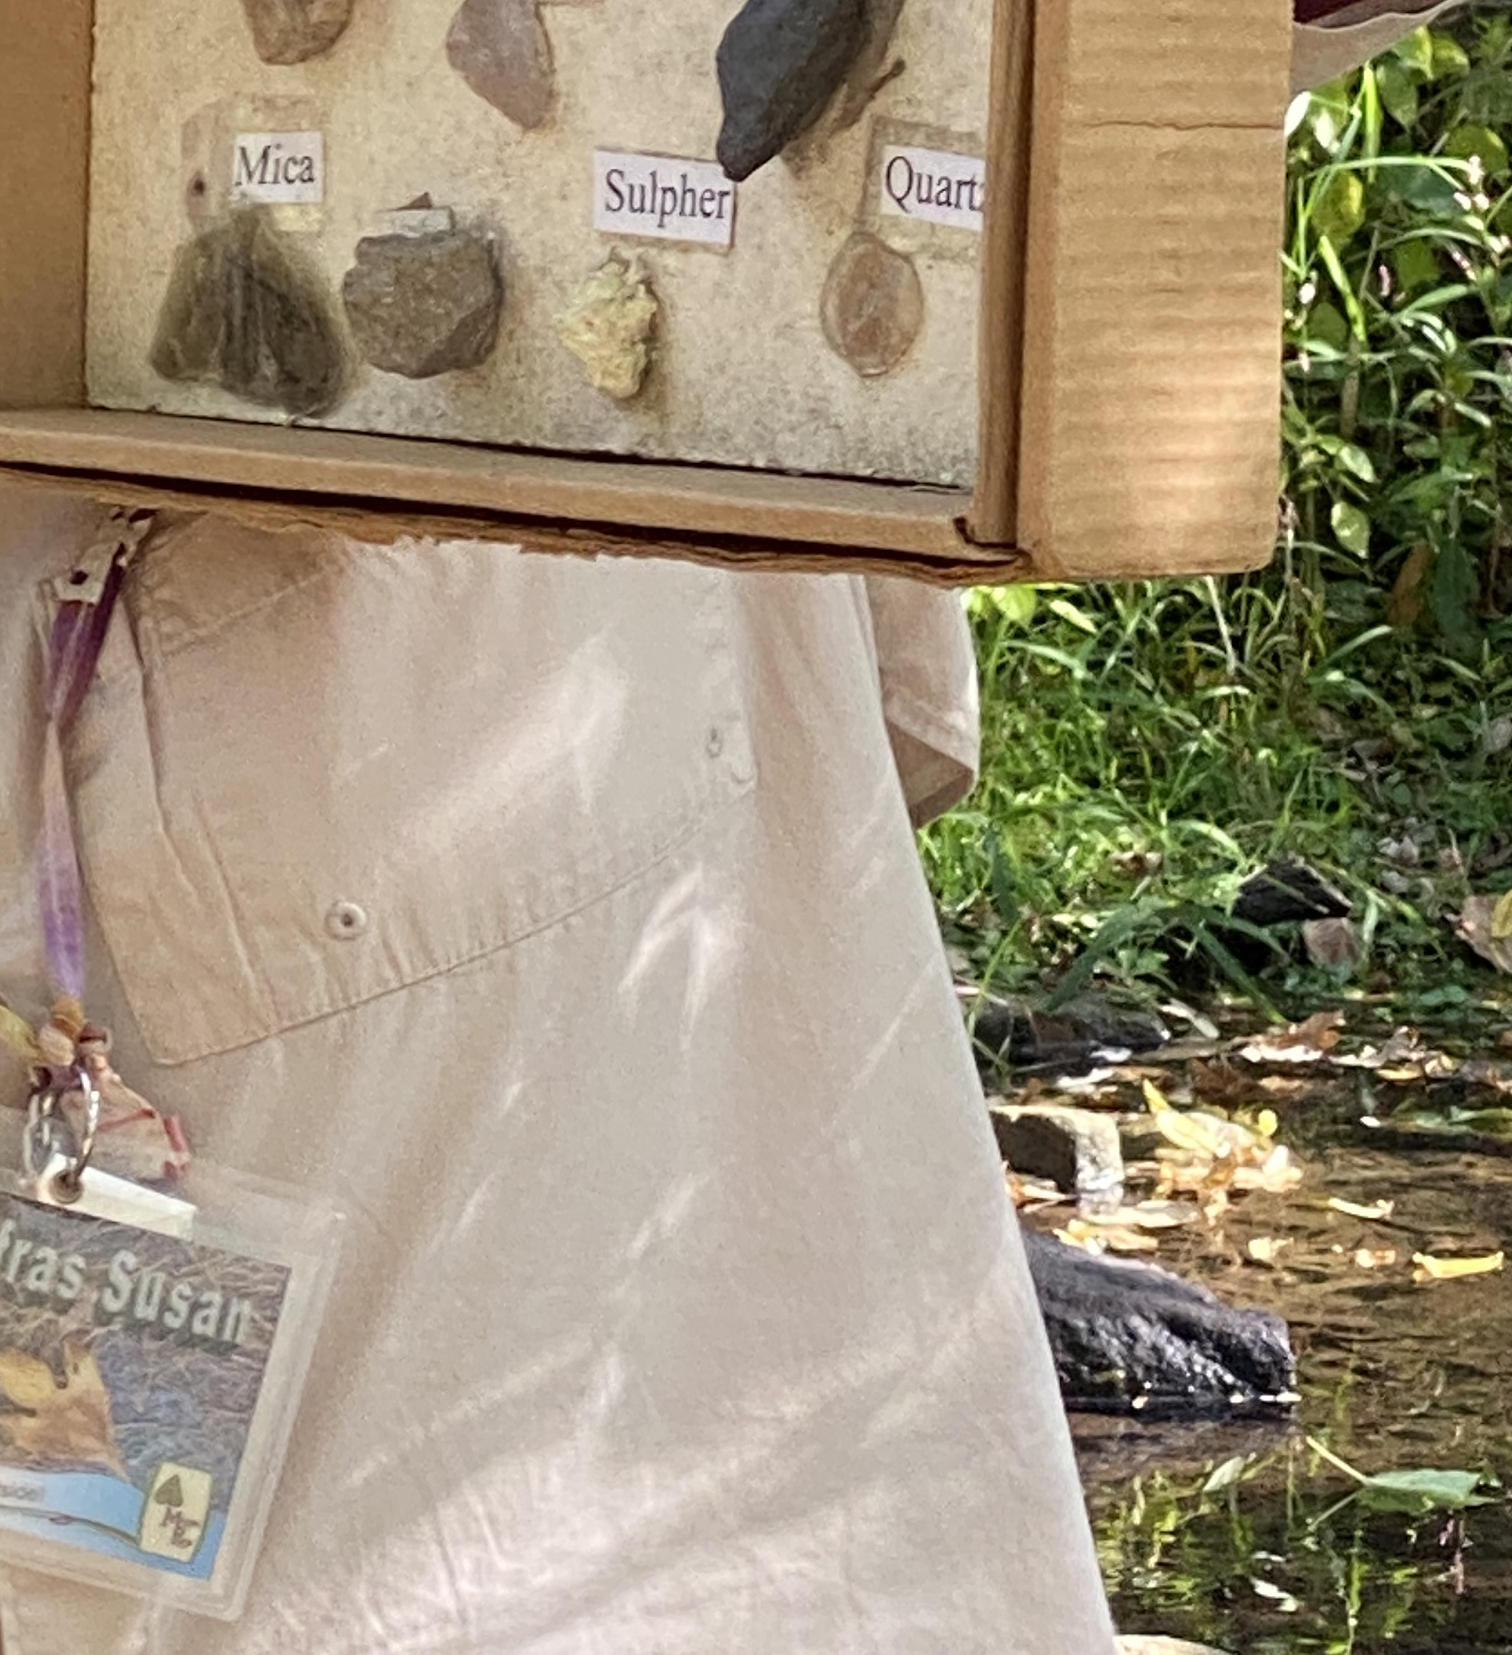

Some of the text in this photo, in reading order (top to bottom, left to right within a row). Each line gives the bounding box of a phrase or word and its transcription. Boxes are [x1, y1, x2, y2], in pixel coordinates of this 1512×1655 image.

[234, 142, 317, 186] Mica
[885, 155, 985, 215] Quart
[604, 167, 731, 228] Sulpher
[101, 1248, 257, 1343] Susan
